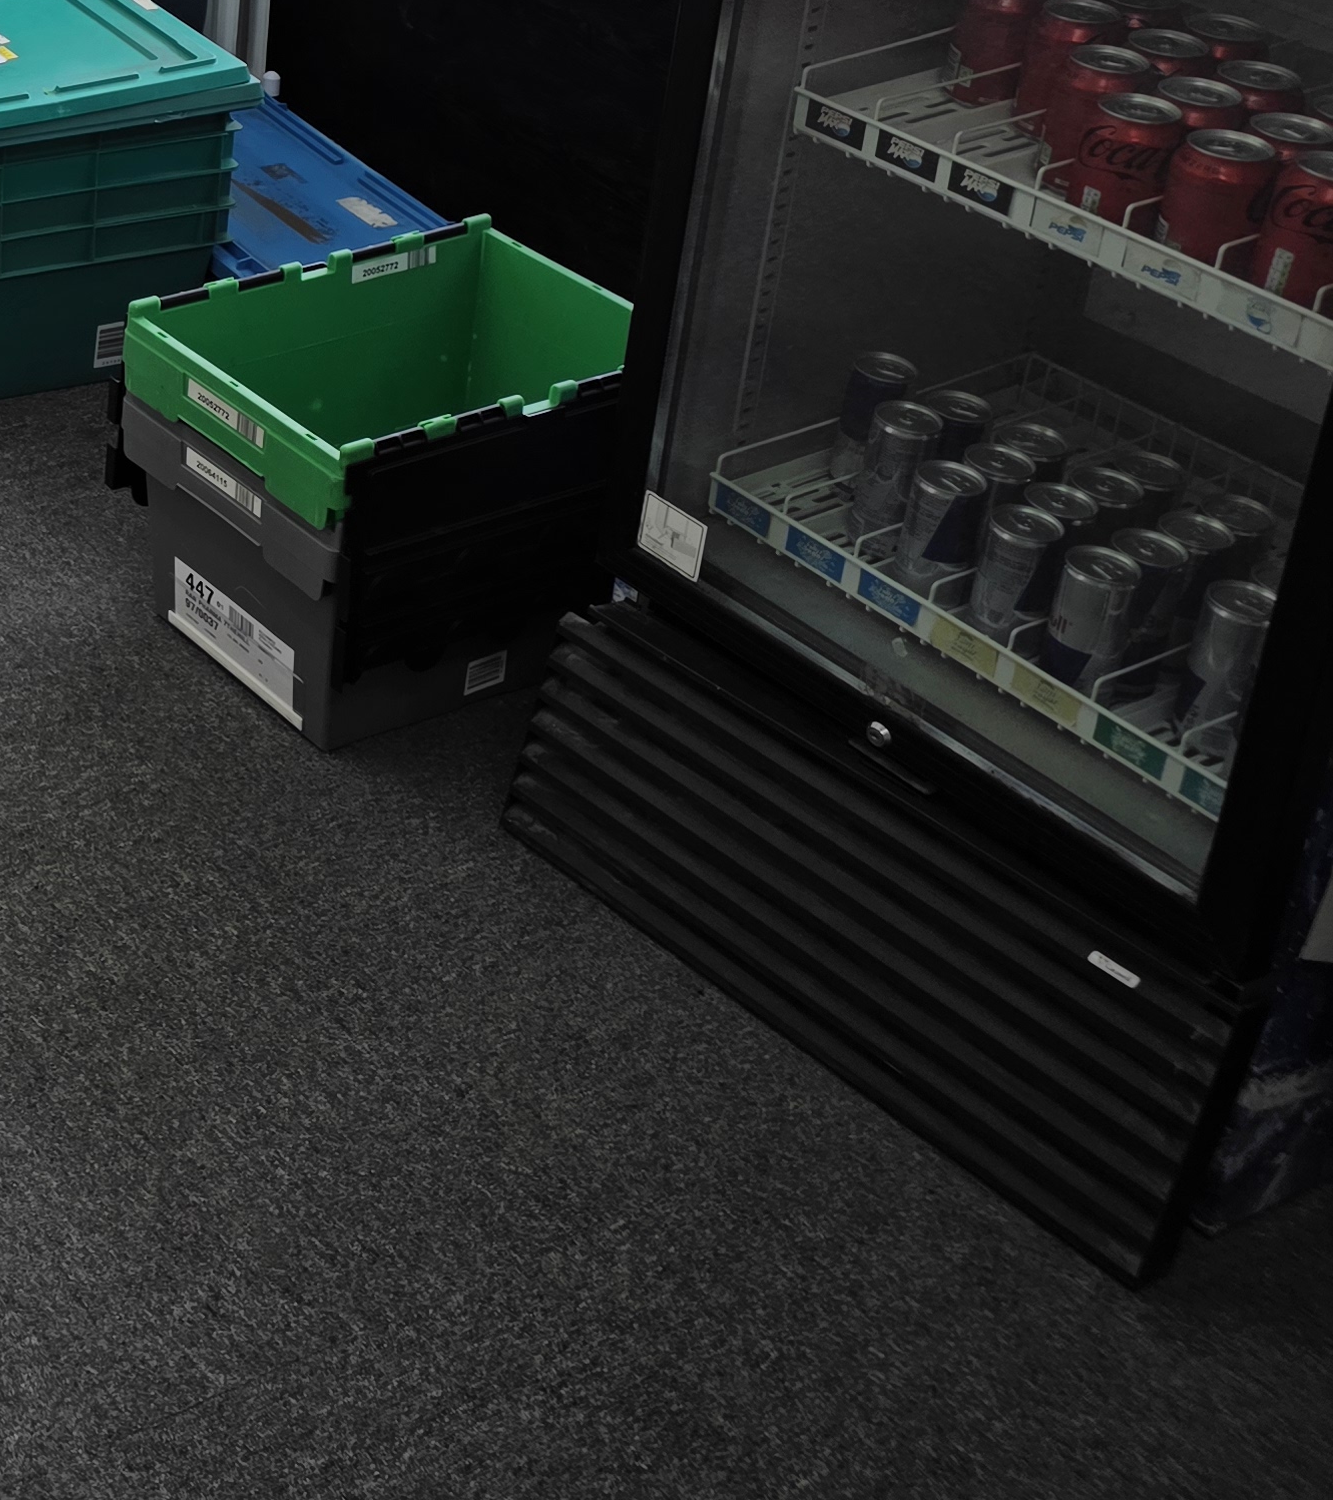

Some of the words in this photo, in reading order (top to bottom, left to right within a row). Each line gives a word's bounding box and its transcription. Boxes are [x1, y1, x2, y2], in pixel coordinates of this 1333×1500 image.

[891, 136, 925, 157] PEPSI
[964, 168, 1001, 190] PEPSI
[1048, 221, 1088, 244] PEPSI
[362, 260, 400, 279] 20052772
[1141, 264, 1182, 287] PEPSI
[196, 390, 232, 422] 20052772
[194, 458, 230, 489] 20064115
[185, 572, 215, 606] 447
[184, 596, 220, 632] 97/0037
